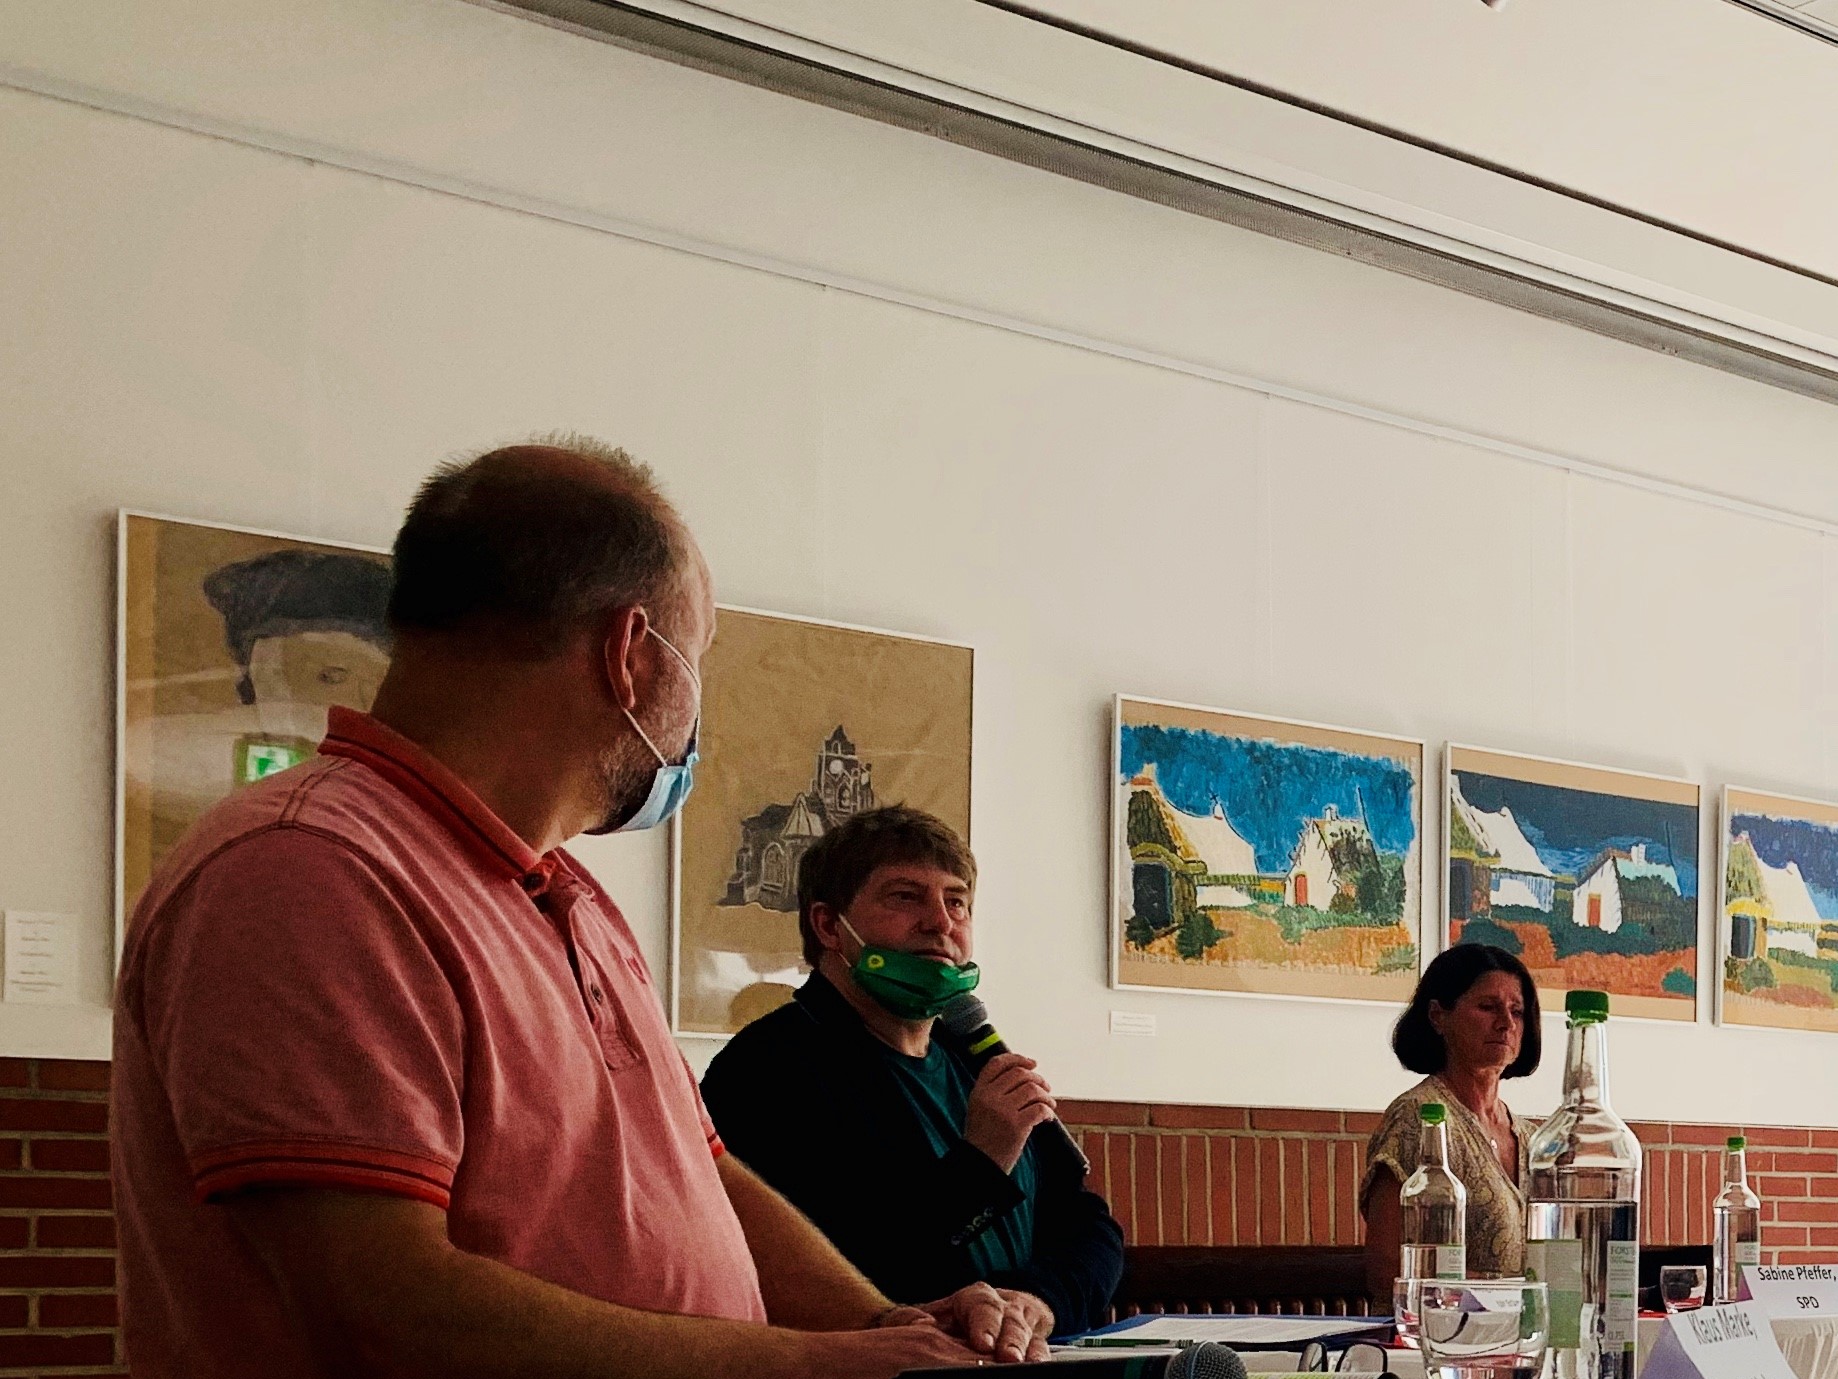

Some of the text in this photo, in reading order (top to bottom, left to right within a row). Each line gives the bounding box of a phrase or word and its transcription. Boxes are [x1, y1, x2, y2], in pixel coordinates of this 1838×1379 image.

[1758, 1265, 1837, 1282] Sabine Pfeffer,
[1796, 1296, 1820, 1309] SPD
[1686, 1312, 1723, 1345] Klaus
